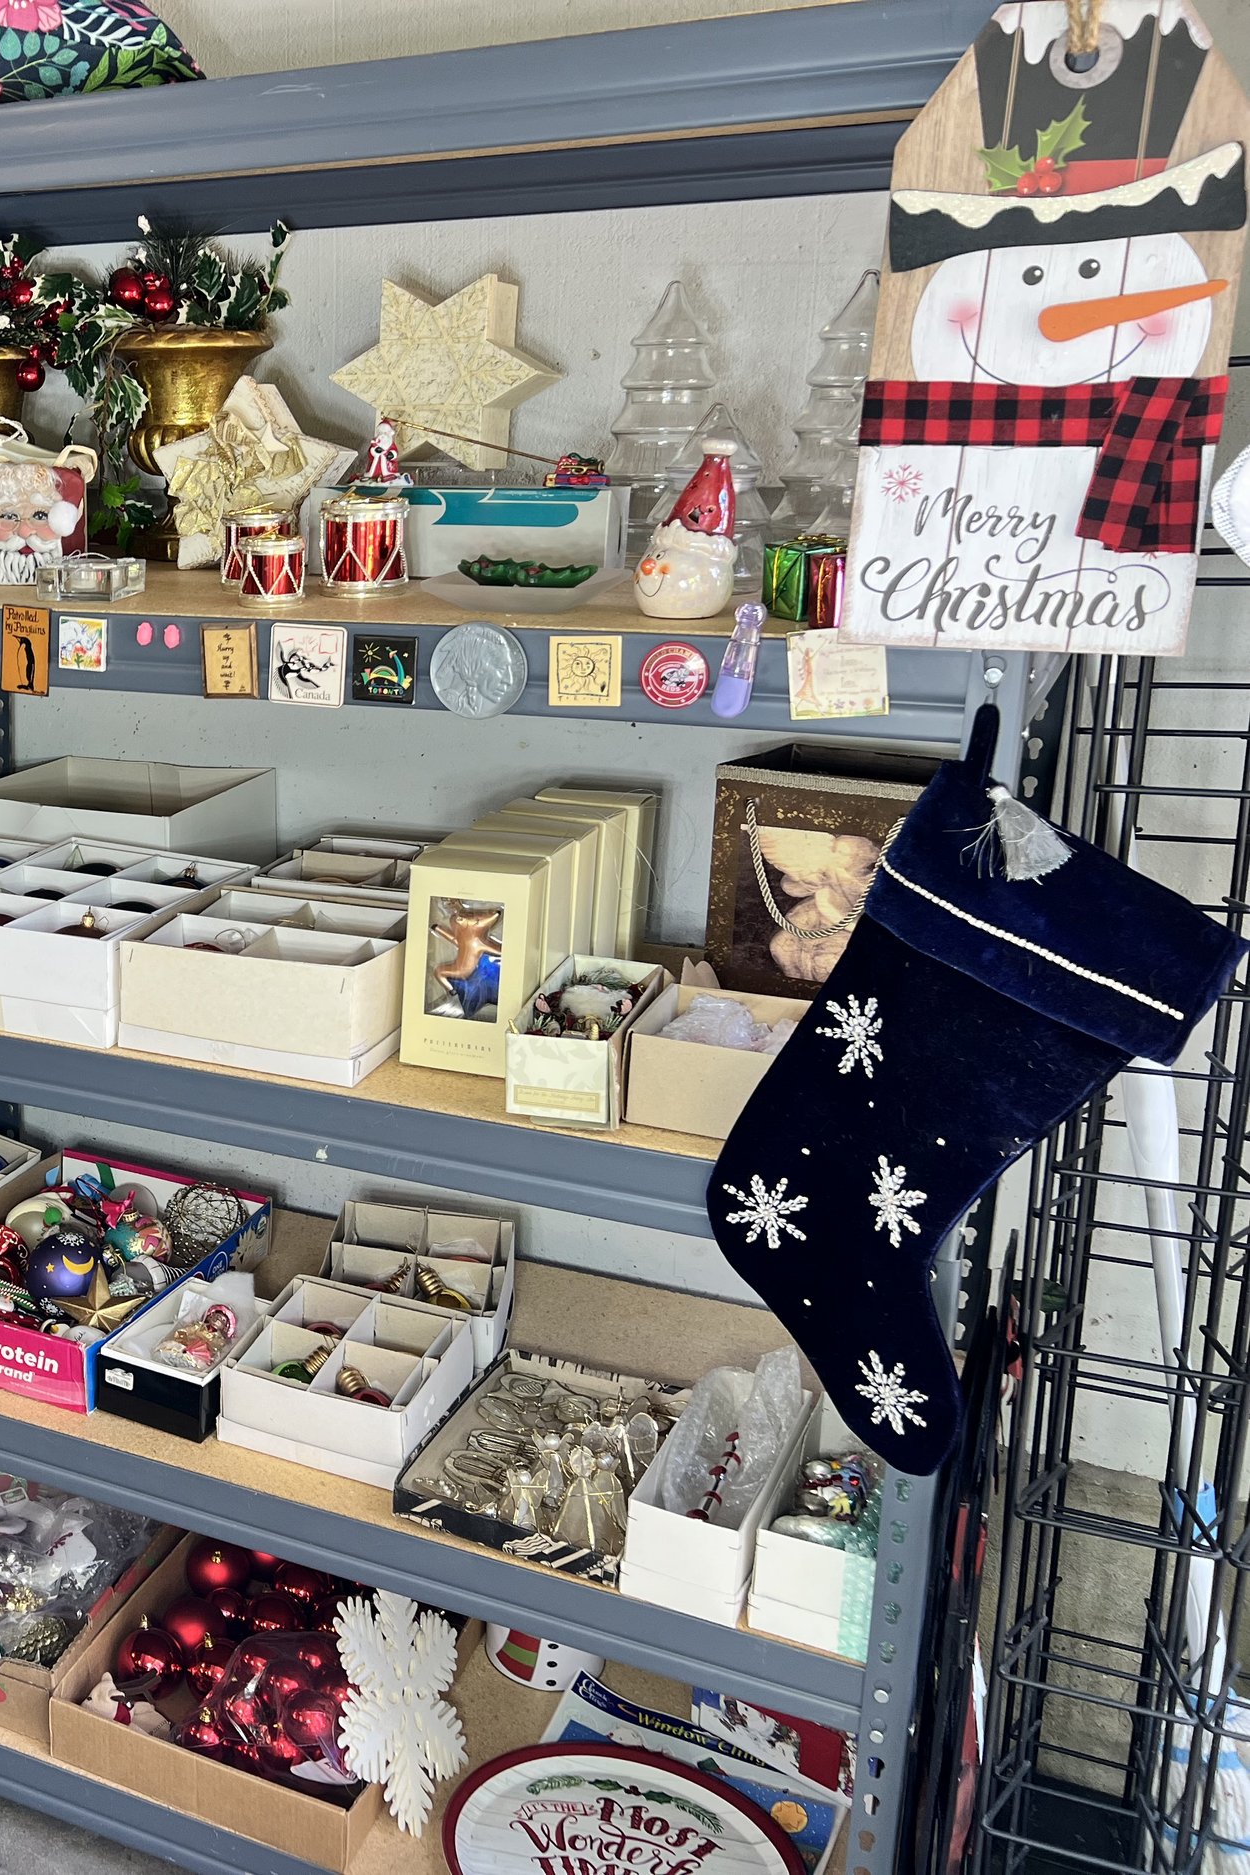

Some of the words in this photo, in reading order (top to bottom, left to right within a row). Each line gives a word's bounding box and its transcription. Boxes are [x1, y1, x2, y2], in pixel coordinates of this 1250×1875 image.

[914, 487, 1057, 564] Merry
[860, 554, 1170, 633] Christmas
[13, 621, 46, 636] Penguins
[217, 643, 234, 654] Hurry
[221, 661, 232, 669] and
[222, 655, 230, 663] up
[294, 686, 331, 701] Canada
[368, 686, 404, 696] TORONTO
[661, 683, 682, 692] REDS
[638, 1711, 708, 1745] Window
[526, 1801, 548, 1814] IT'S
[553, 1802, 579, 1813] THE
[509, 1814, 702, 1875] Wonderf
